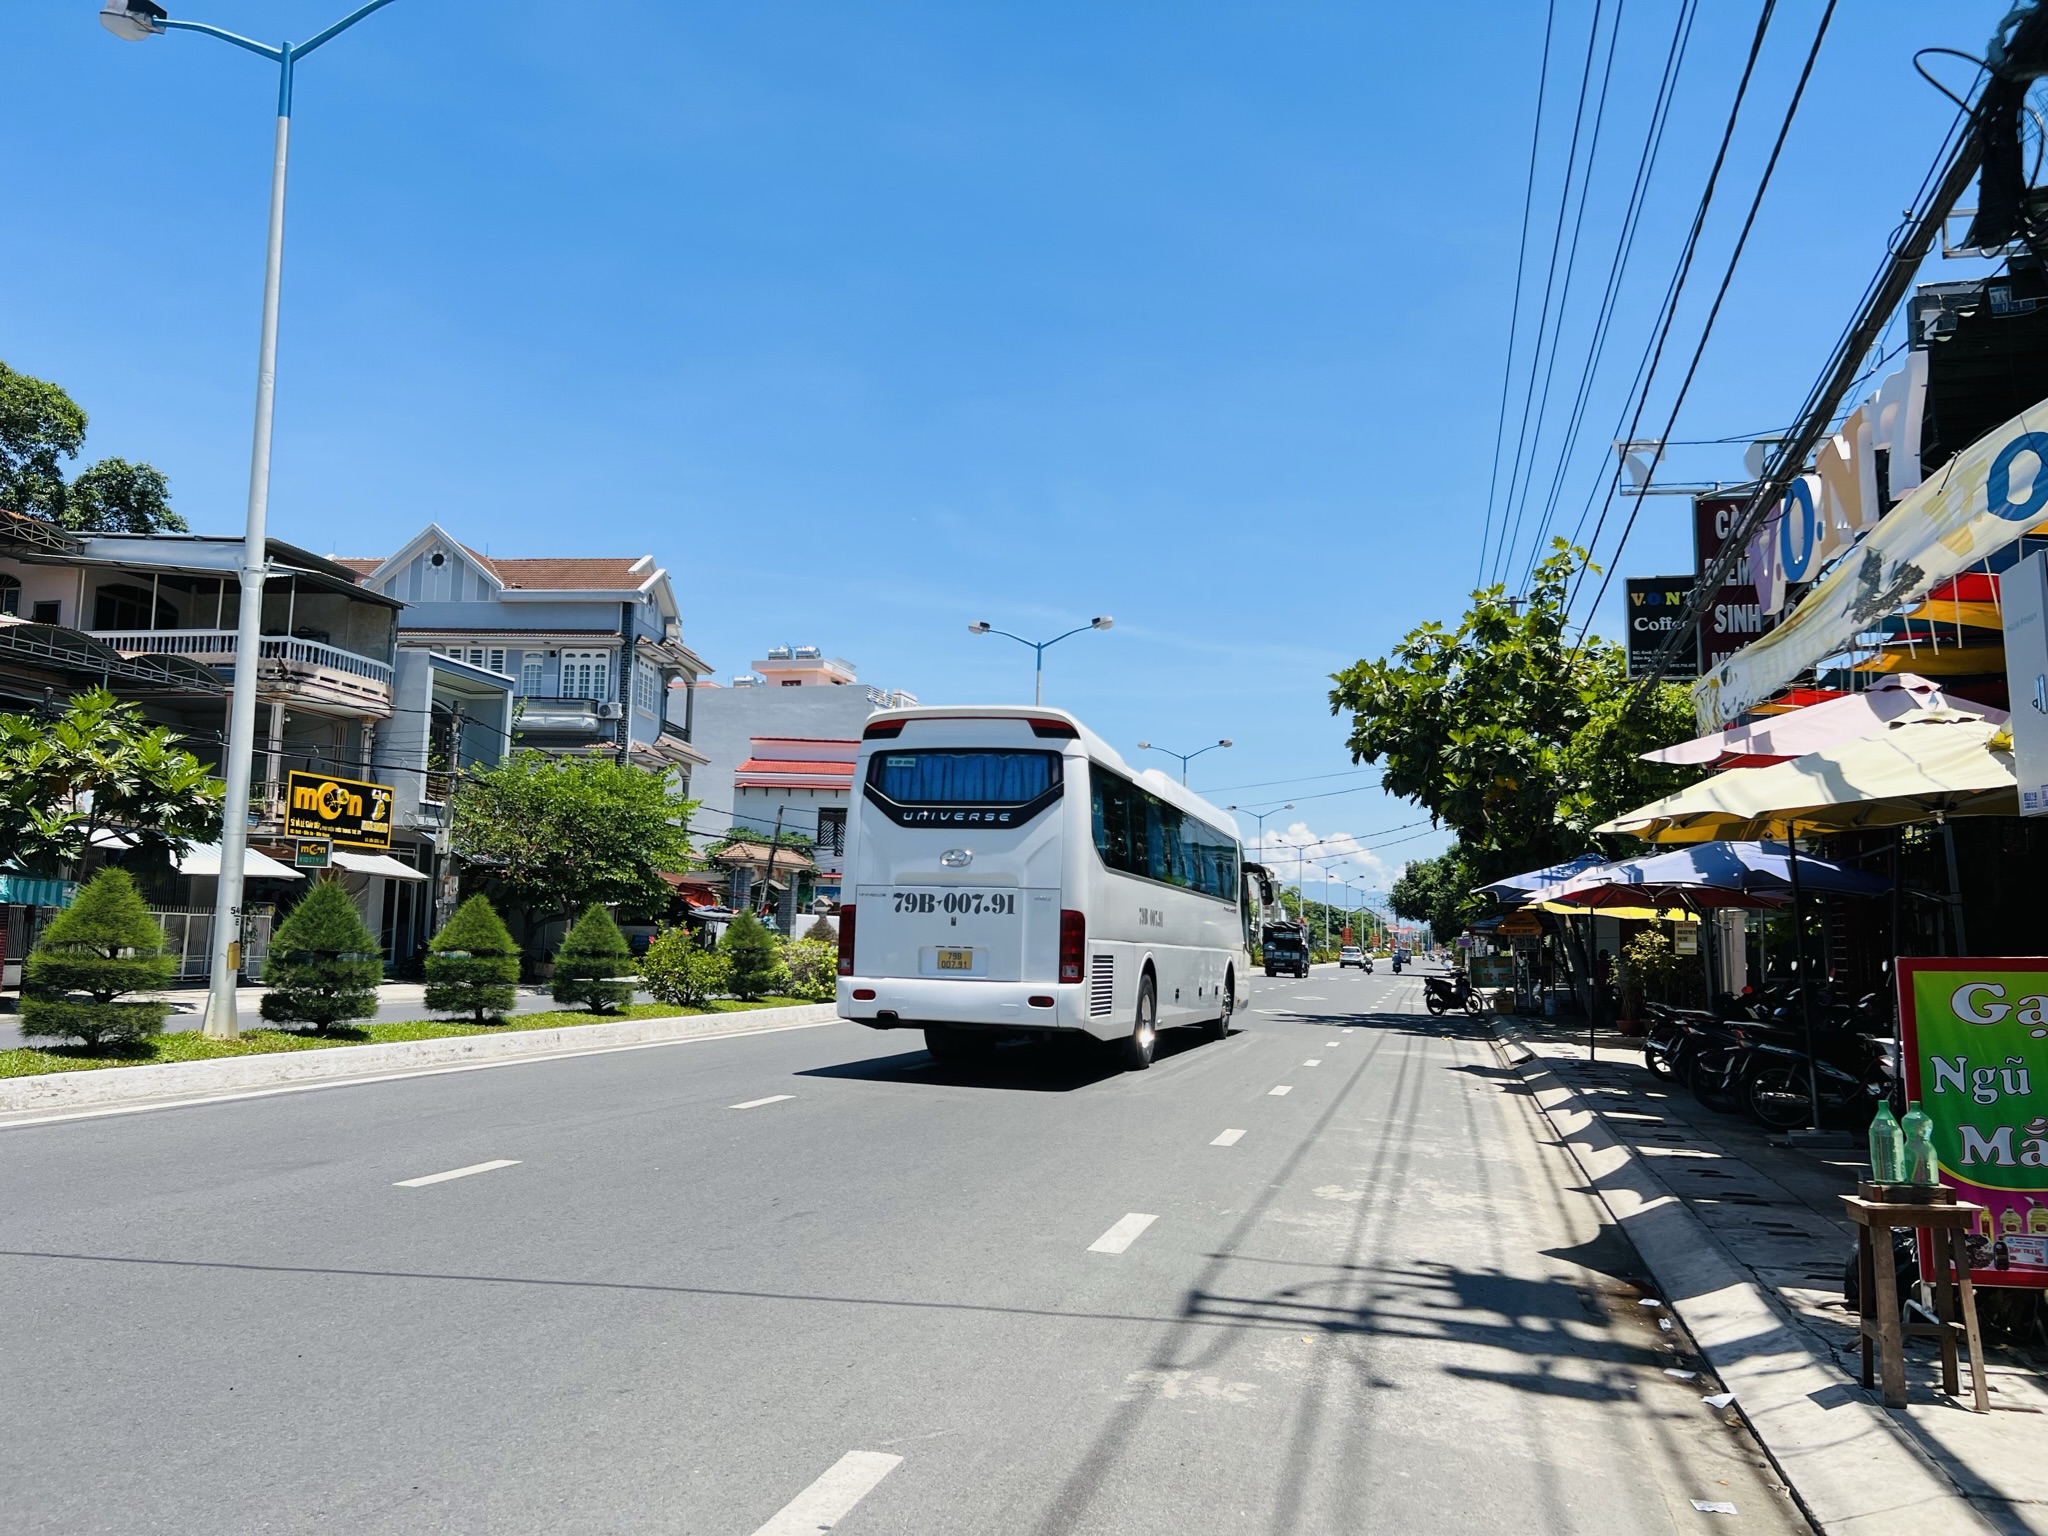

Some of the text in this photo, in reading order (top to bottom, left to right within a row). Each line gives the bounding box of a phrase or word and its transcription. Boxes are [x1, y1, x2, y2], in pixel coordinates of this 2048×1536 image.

[1714, 604, 1761, 634] SINH
[903, 811, 1011, 822] UNIVERSE
[1929, 1055, 2033, 1105] Ngũ
